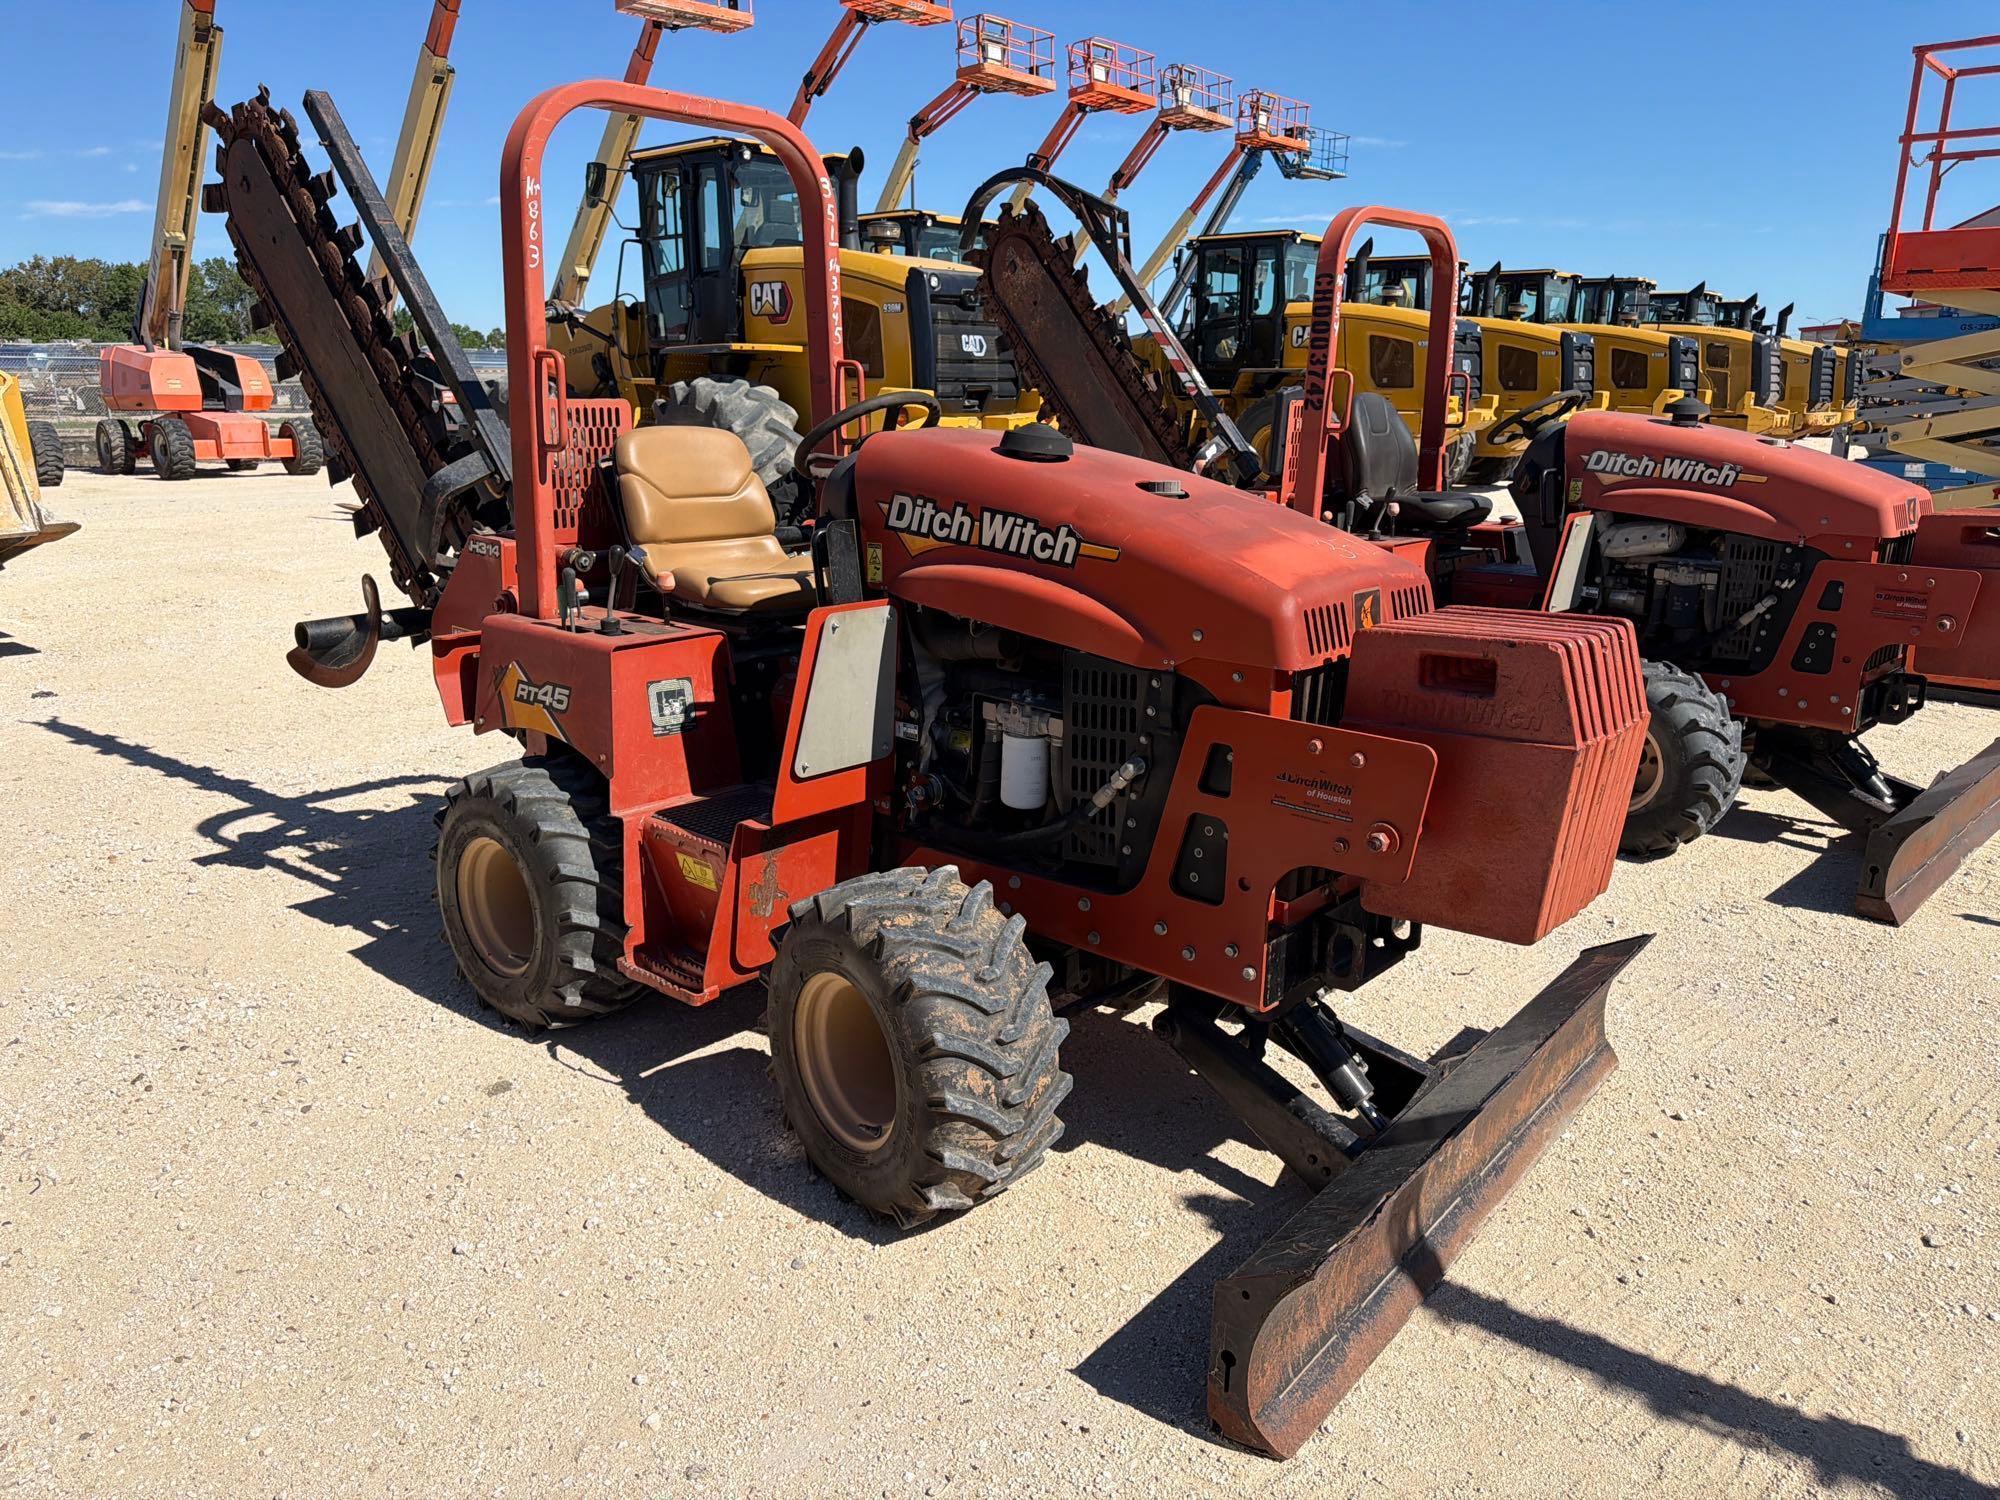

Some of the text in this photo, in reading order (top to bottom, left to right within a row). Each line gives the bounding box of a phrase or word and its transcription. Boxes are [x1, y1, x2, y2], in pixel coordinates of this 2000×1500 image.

[528, 200, 539, 268] 863
[751, 282, 782, 315] CAT
[961, 335, 982, 353] CAT
[1292, 326, 1311, 348] CA
[1587, 451, 1737, 487] Ditch Witch
[887, 494, 1078, 564] Ditch Witch
[516, 684, 570, 711] RT45
[1316, 791, 1352, 805] Houston
